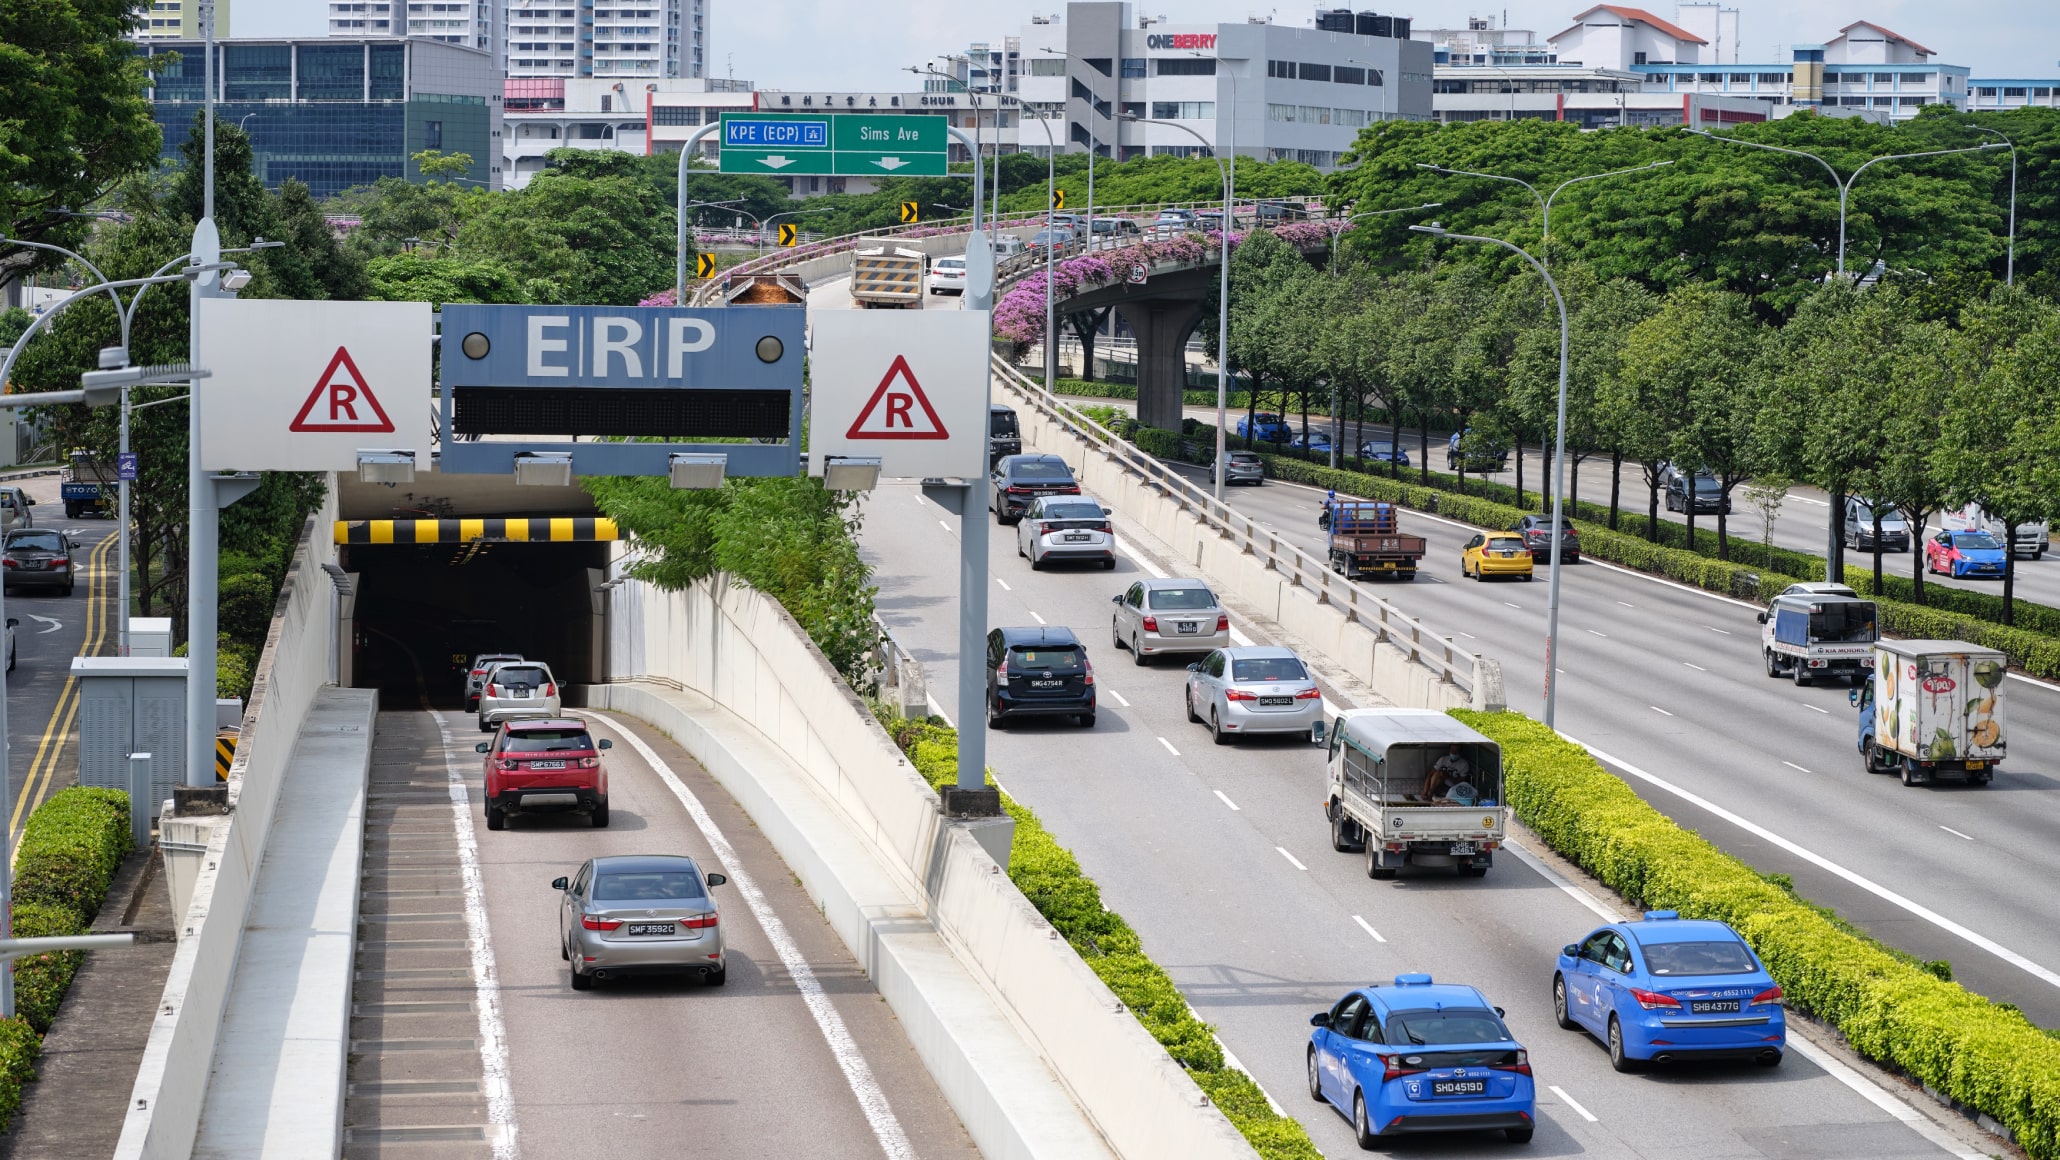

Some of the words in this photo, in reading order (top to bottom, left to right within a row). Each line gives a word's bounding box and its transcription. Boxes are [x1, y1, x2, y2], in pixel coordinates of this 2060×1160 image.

[1147, 34, 1217, 49] ONEBERRY
[921, 96, 955, 106] SHUN
[730, 126, 756, 140] KPE
[763, 126, 799, 142] (ECP)
[860, 126, 890, 141] Sims
[897, 127, 919, 141] Ave
[329, 384, 359, 421] R
[885, 393, 914, 428] R
